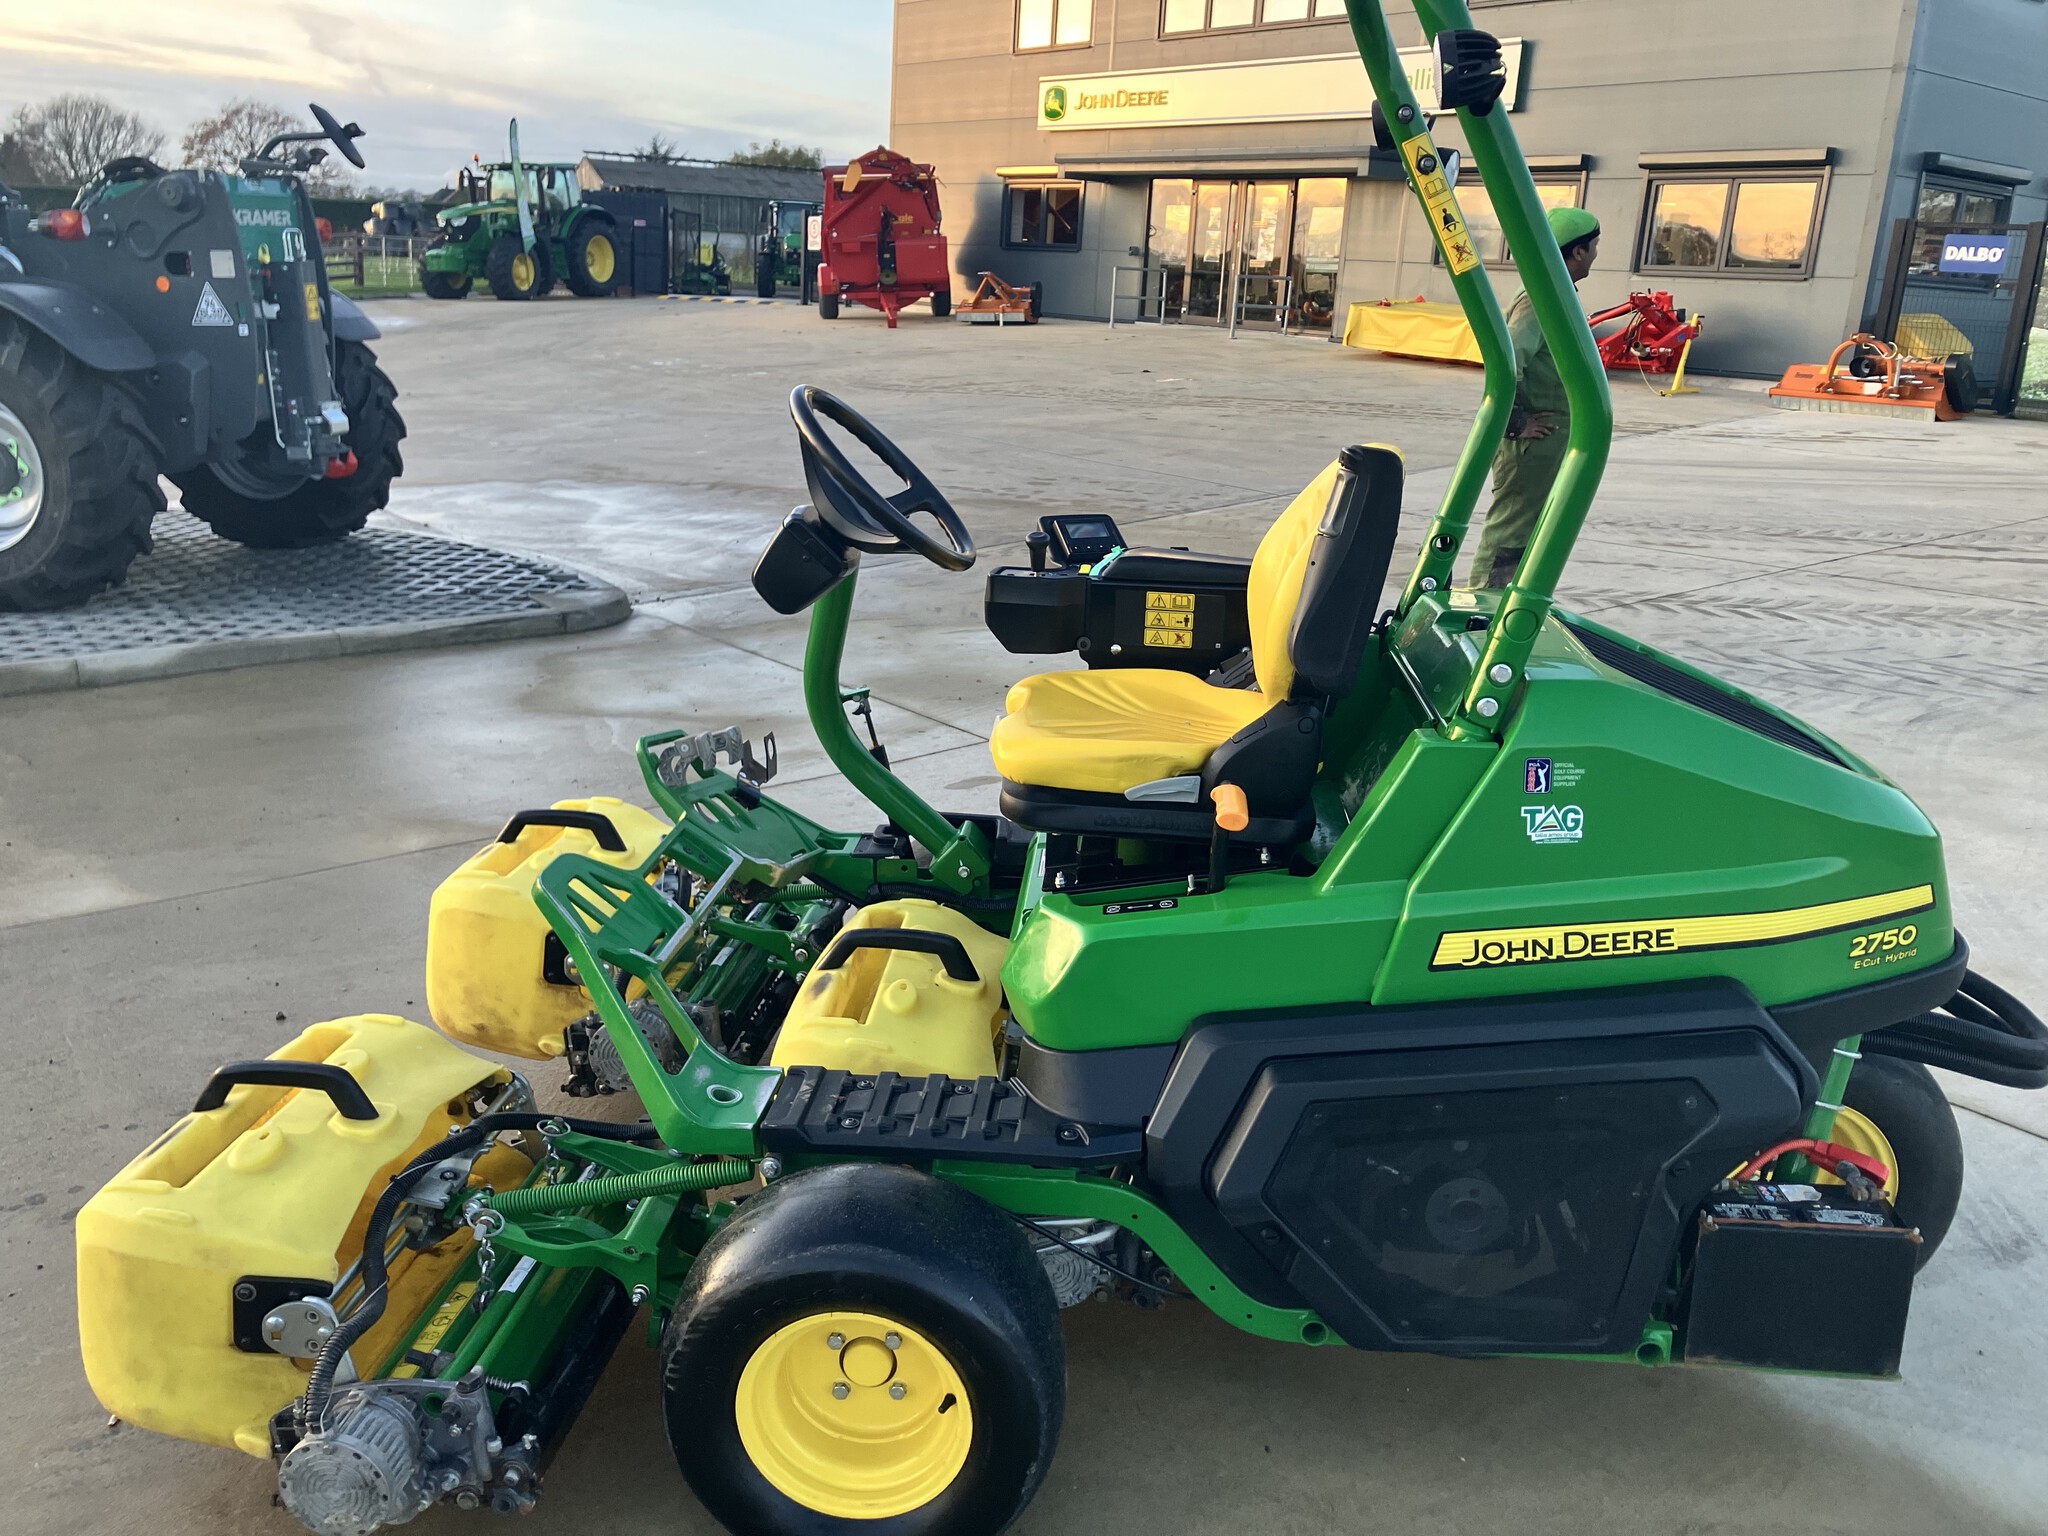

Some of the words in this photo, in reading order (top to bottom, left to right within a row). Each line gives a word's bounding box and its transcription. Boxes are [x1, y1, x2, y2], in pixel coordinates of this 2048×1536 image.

[1074, 92, 1114, 110] JOHN
[1116, 89, 1169, 107] DEERE
[232, 208, 292, 226] KRAMER
[1521, 805, 1583, 833] TAG
[1462, 938, 1554, 962] JOHN
[1563, 928, 1676, 956] DEERE
[1849, 925, 1918, 957] 2750
[1885, 948, 1917, 963] Hybrid
